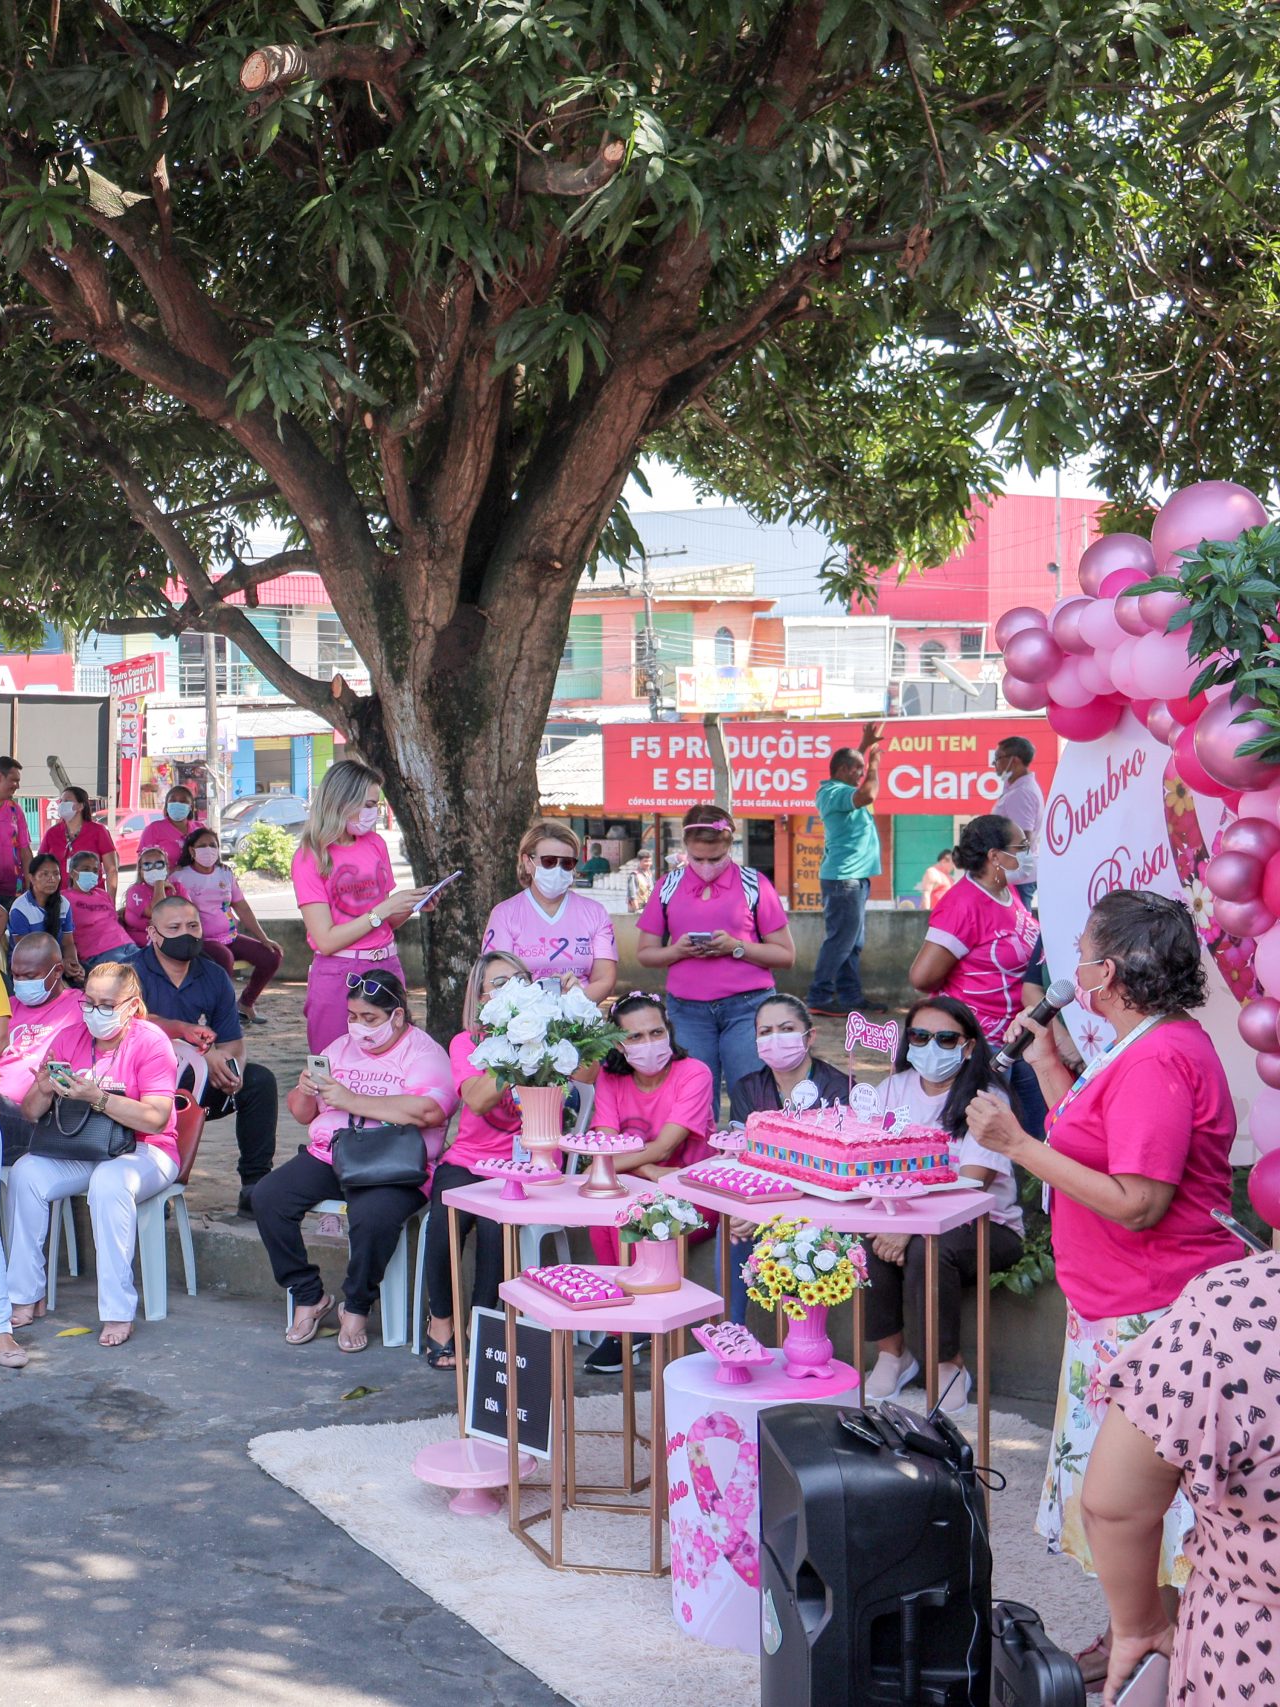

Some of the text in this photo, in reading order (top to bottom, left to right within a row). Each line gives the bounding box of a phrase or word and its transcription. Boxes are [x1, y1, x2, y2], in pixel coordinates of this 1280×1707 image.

[110, 662, 155, 682] Centro Comercial
[110, 673, 155, 697] PAMELA
[630, 736, 661, 759] F5
[888, 735, 977, 753] AQUI TEM
[653, 768, 808, 797] E SEVIÇOS
[887, 764, 1005, 801] Claro
[627, 796, 654, 807] CÓPIAS
[656, 798, 667, 807] DE
[755, 799, 782, 808] GERAL
[790, 799, 816, 808] FOTOS
[1046, 748, 1146, 857] Outubro
[1088, 842, 1169, 911] Rosa
[518, 947, 545, 958] ROSA
[862, 1034, 887, 1050] LESTE
[865, 1025, 884, 1039] DISA
[348, 1069, 406, 1089] Outubro
[350, 1080, 388, 1097] Rosa
